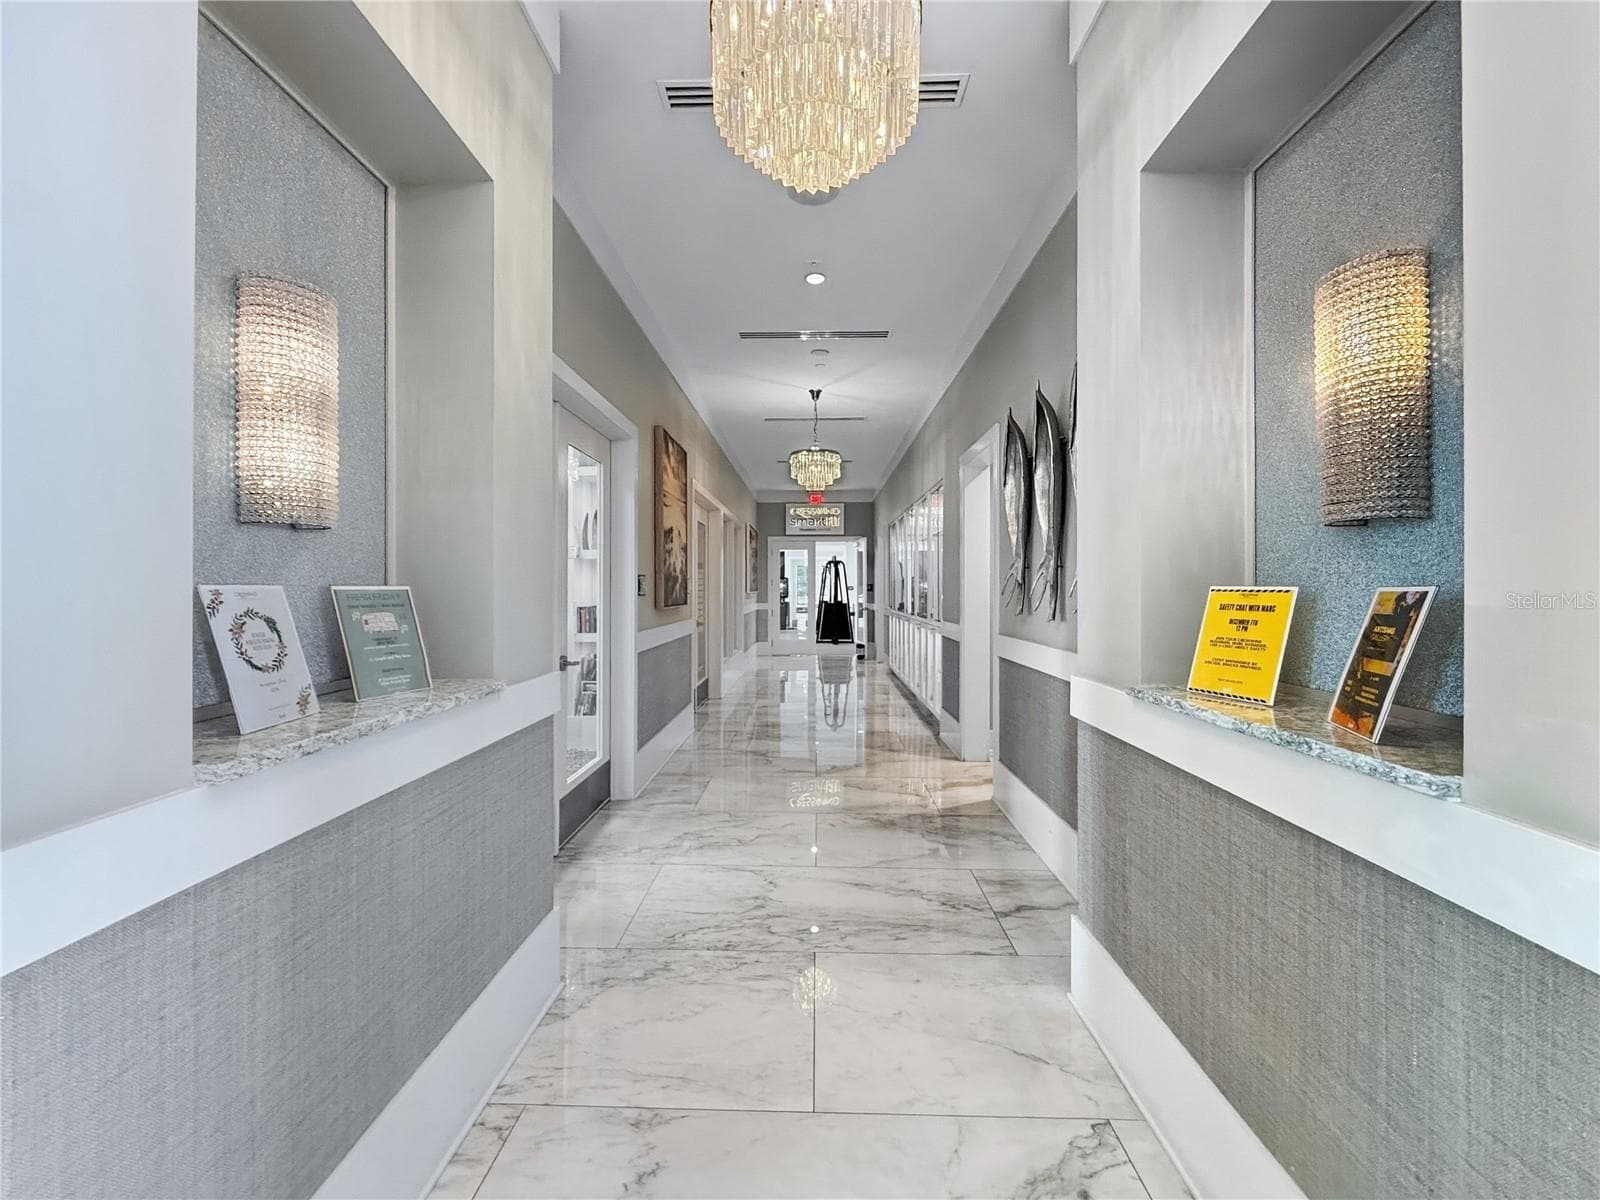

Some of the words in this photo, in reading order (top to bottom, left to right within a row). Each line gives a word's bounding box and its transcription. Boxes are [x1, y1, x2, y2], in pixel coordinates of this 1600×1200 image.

[1219, 603, 1235, 611] SAFETY
[1248, 604, 1261, 612] WITH
[1261, 605, 1276, 613] MARC
